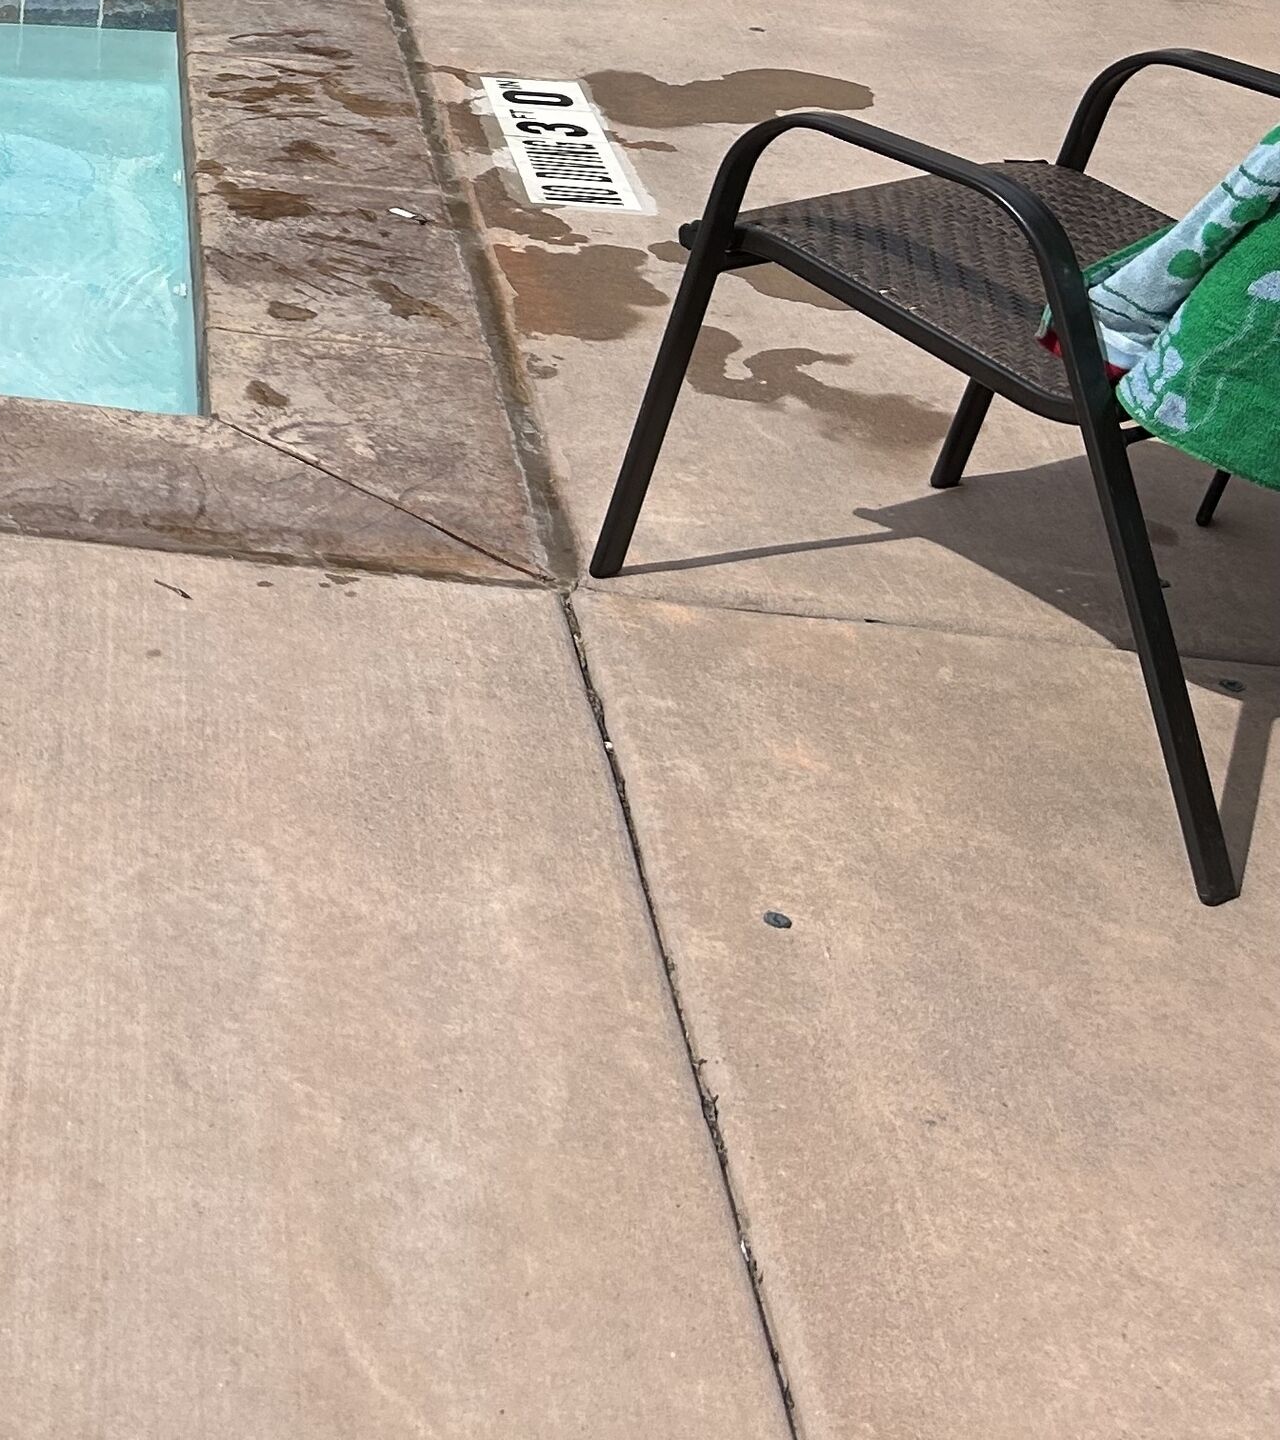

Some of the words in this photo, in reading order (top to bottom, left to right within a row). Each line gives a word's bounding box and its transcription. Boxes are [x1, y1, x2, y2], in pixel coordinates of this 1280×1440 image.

[496, 79, 523, 90] IN
[502, 90, 574, 107] 0
[509, 109, 537, 120] FT
[515, 120, 589, 138] 3
[522, 140, 613, 184] DIVING
[541, 185, 625, 206] NO
